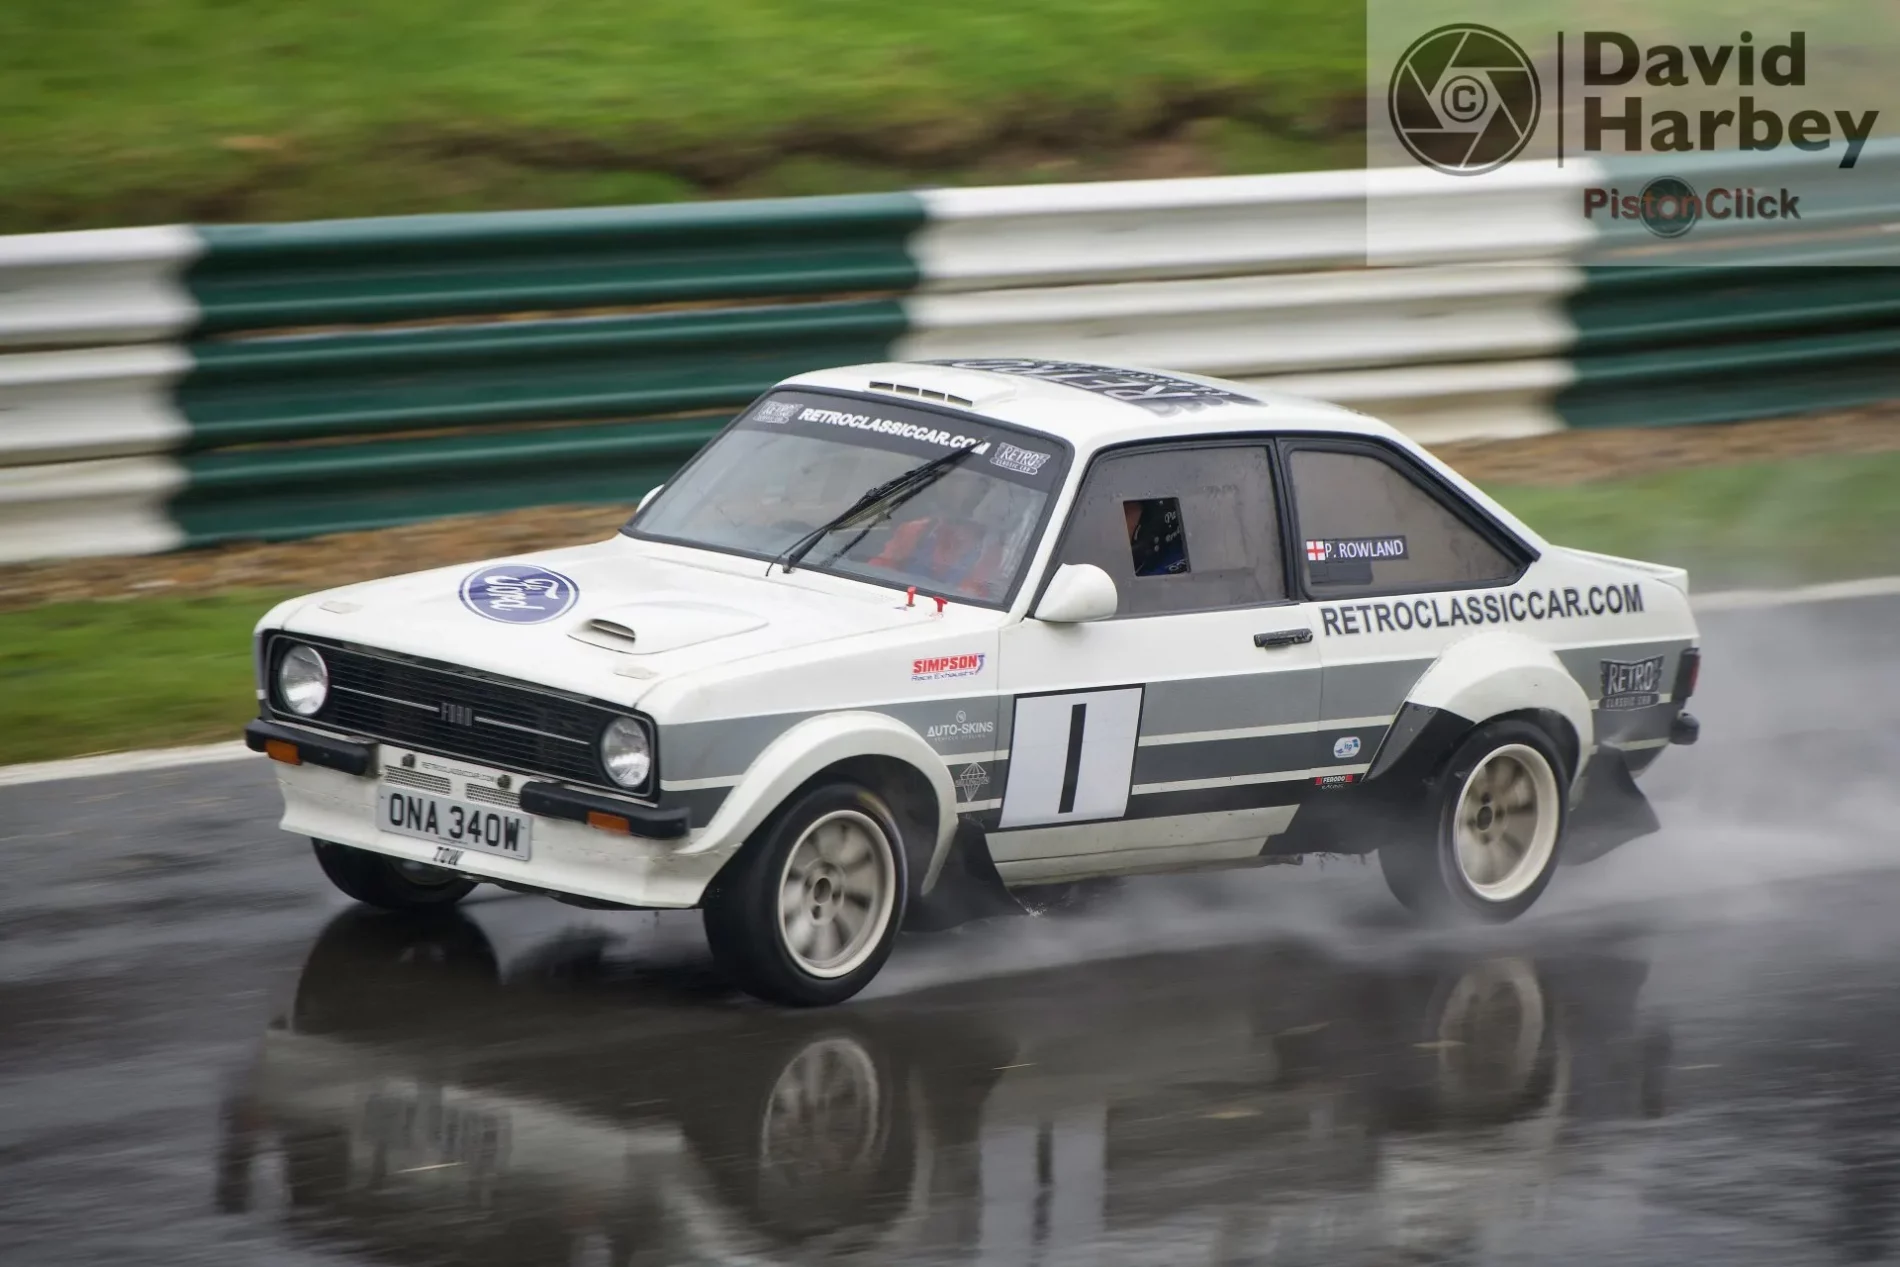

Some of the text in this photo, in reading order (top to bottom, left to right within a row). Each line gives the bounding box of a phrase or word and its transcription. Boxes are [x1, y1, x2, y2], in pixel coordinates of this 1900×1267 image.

[798, 408, 991, 455] RETROCLASSICCAR.COM
[1000, 446, 1039, 466] RETRO
[1325, 540, 1403, 558] P. ROWLAND
[1320, 584, 1644, 636] RETROCLASSICCAR.COM
[913, 655, 978, 674] SIMPSON
[1607, 661, 1654, 695] RETRO
[927, 721, 993, 737] AUTO-SKINS
[1322, 775, 1346, 784] FERODO
[390, 793, 520, 852] ONA 340W
